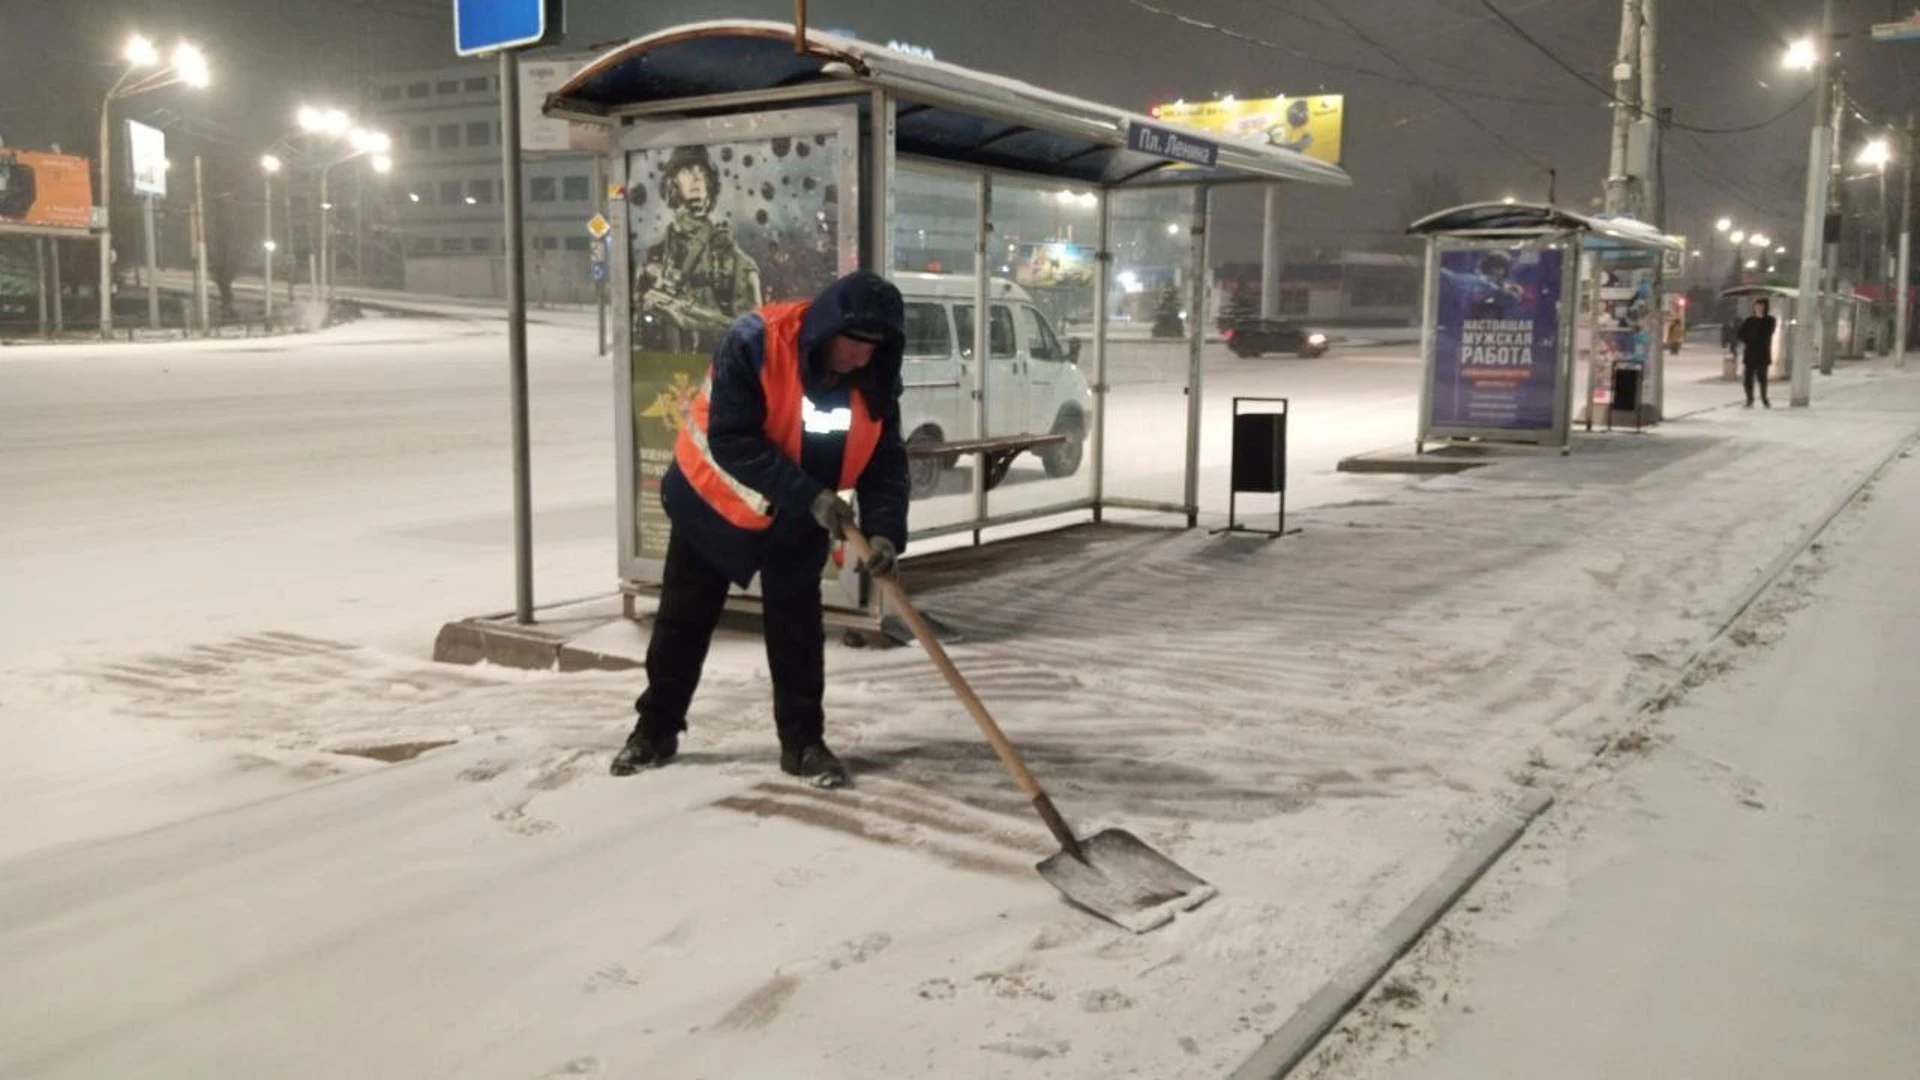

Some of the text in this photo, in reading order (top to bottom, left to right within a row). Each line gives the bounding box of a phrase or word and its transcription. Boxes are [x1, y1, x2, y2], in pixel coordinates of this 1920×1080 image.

[1138, 127, 1211, 165] Пл. Ленина
[1463, 319, 1533, 331] НАСТОЯЩАЯ
[1462, 332, 1532, 346] МУЖСКАЯ
[1461, 346, 1532, 365] РАБОТА
